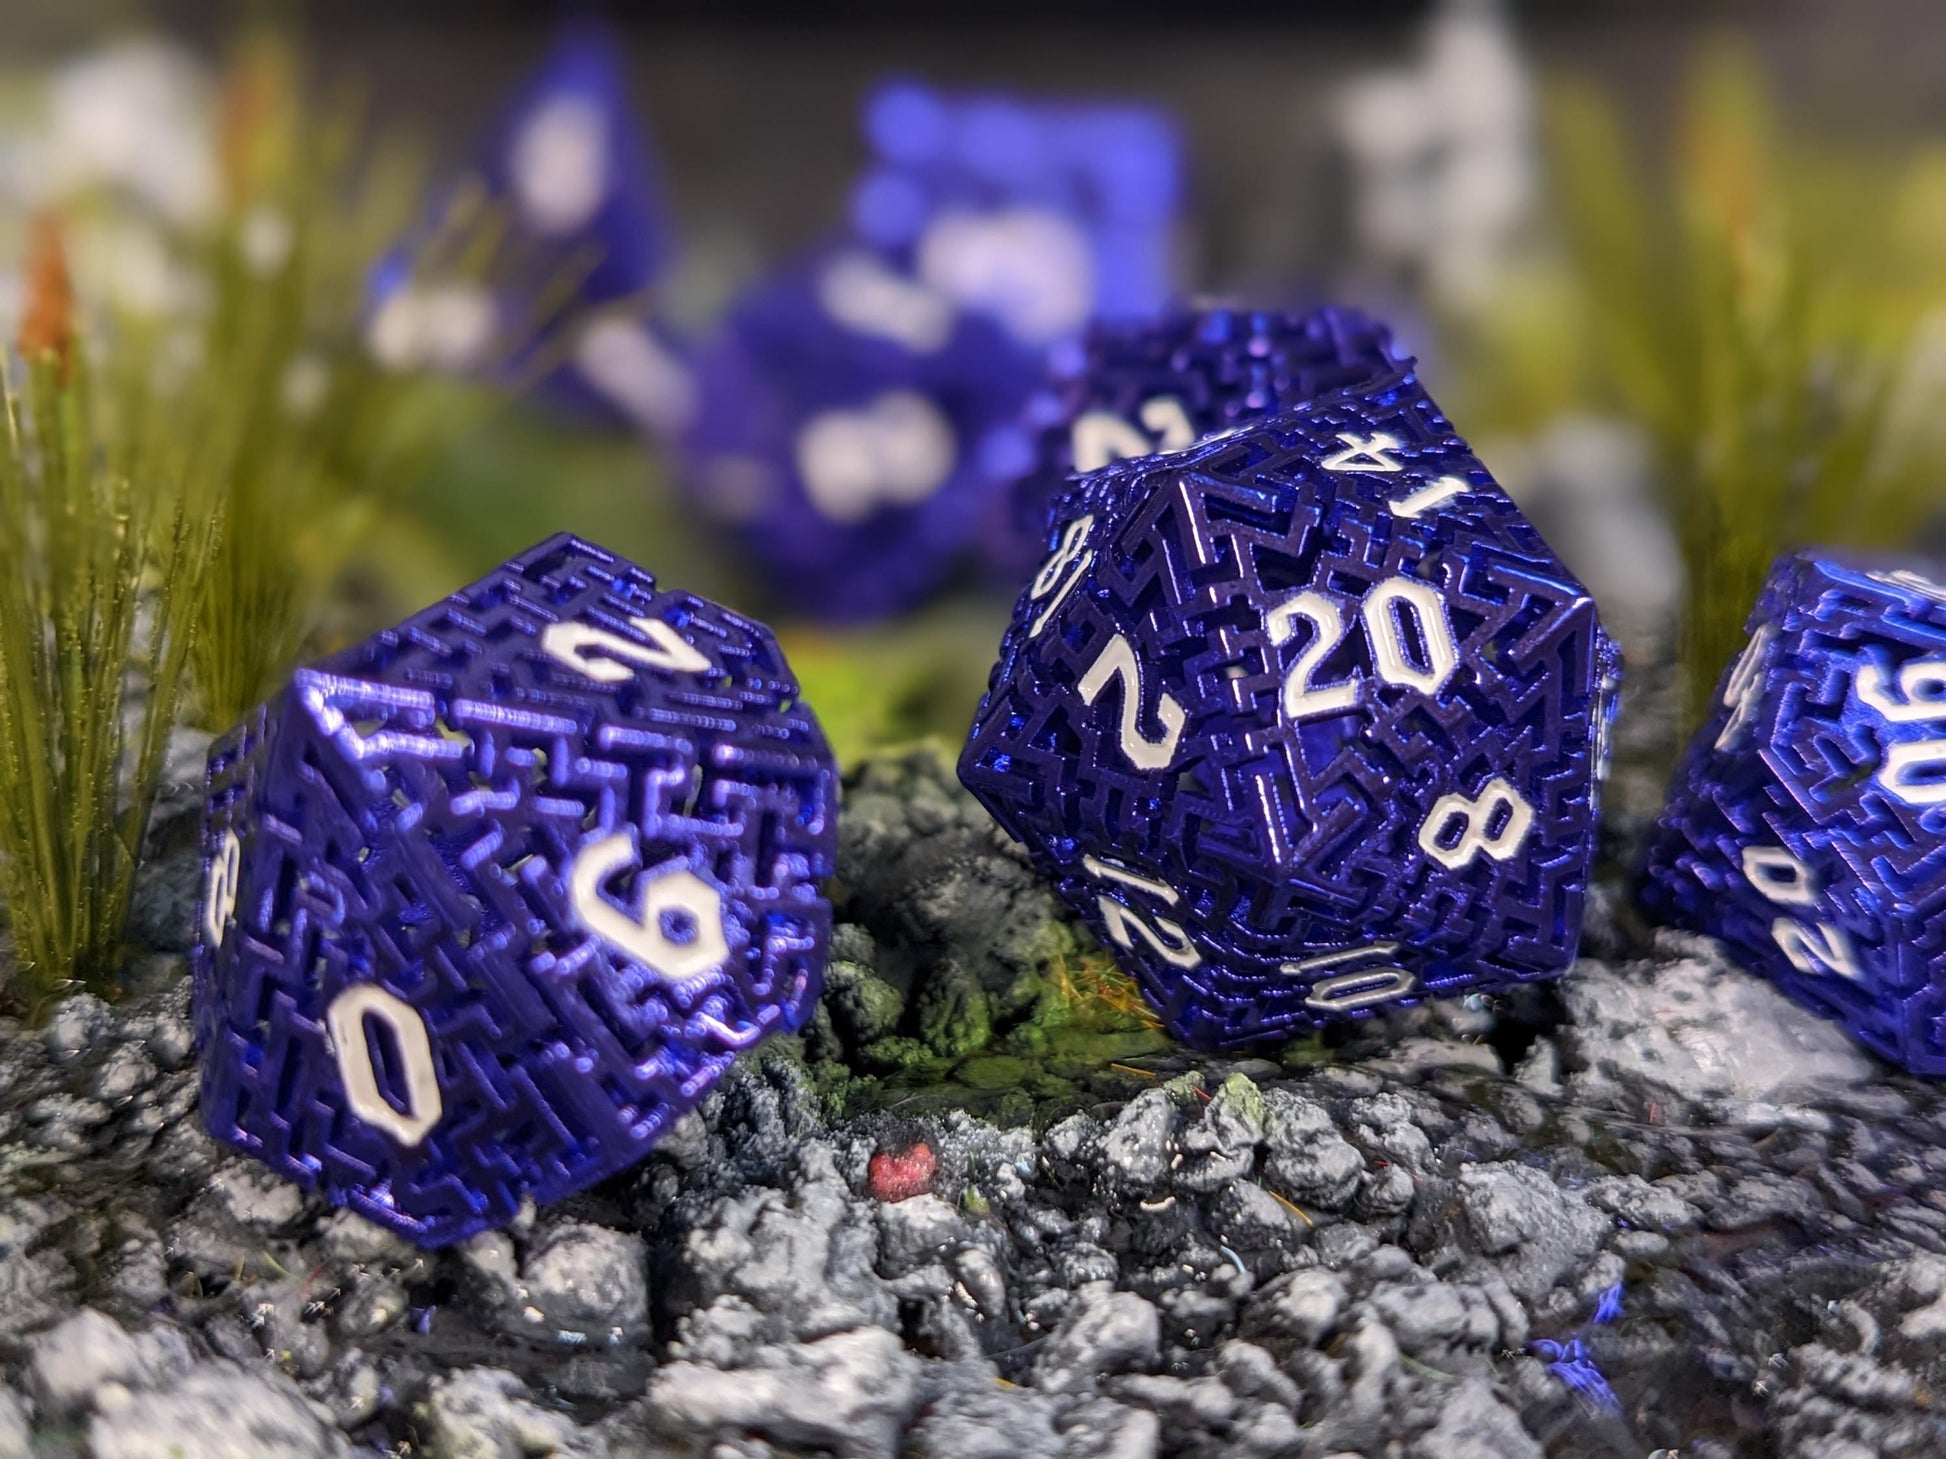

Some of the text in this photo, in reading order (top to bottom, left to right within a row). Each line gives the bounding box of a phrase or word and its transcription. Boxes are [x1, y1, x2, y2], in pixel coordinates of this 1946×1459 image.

[1321, 432, 1472, 518] 14
[1029, 514, 1094, 638] 18
[540, 617, 712, 681] 2
[1078, 635, 1187, 770] 2
[1269, 576, 1459, 719] 20
[1419, 779, 1534, 869] 8
[569, 833, 729, 978] 6
[1083, 853, 1203, 970] 12
[1279, 940, 1417, 1012] 10
[327, 983, 443, 1147] 0
